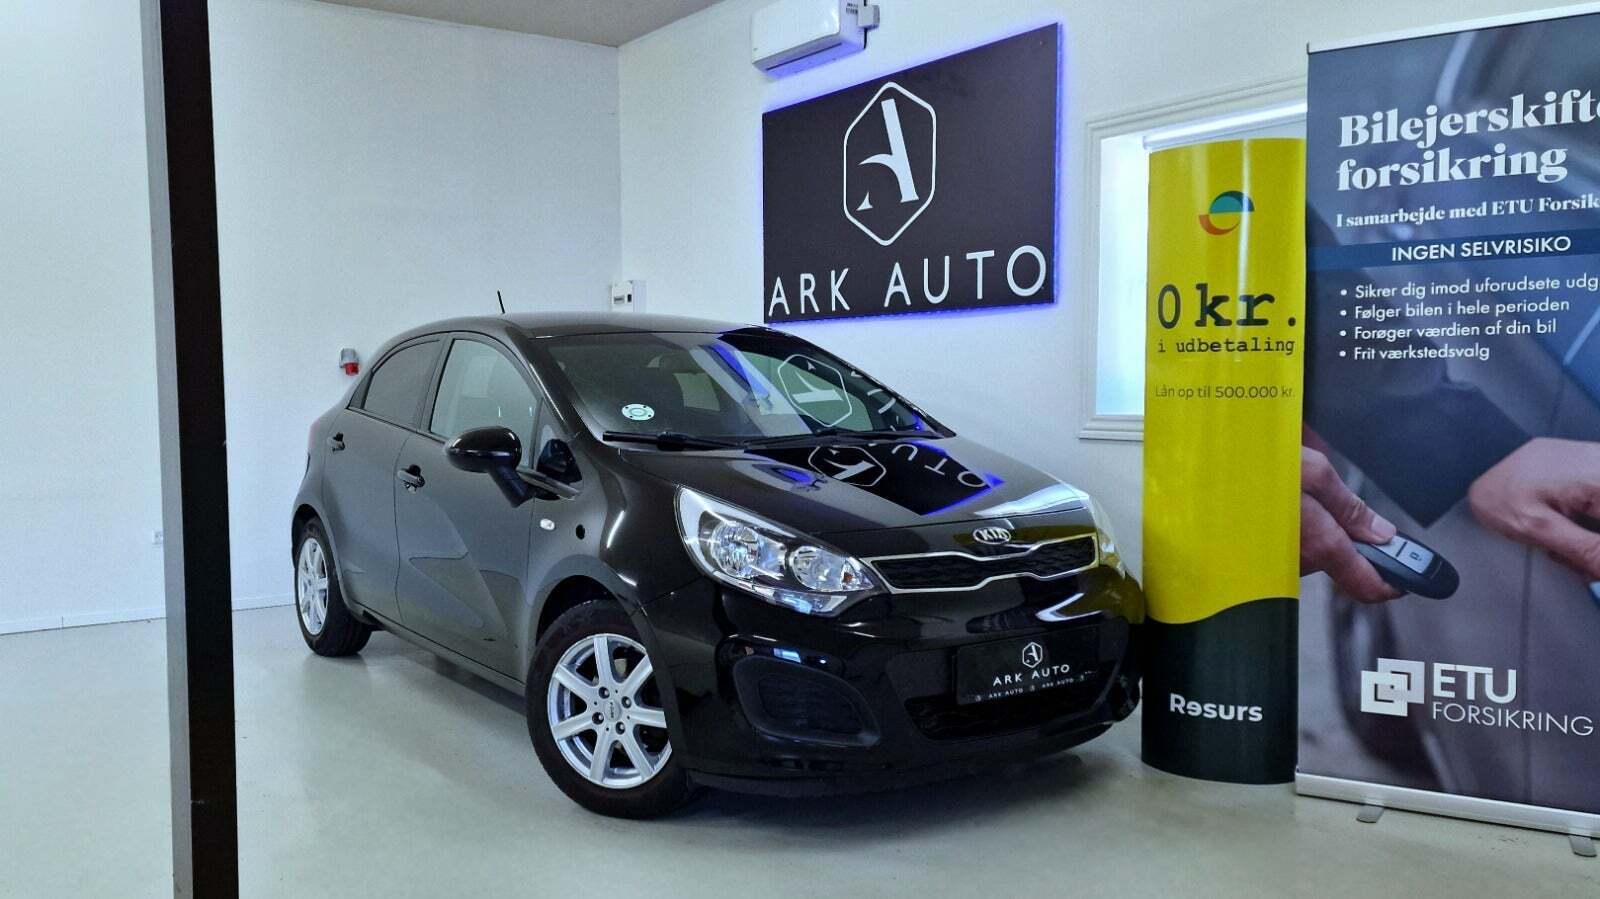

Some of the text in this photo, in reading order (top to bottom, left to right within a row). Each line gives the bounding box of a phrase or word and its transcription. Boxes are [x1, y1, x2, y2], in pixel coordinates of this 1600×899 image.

[1337, 142, 1568, 191] forsikring
[1336, 214, 1344, 228] I
[1346, 206, 1445, 227] samarbejde
[1450, 201, 1487, 219] med
[1492, 199, 1533, 216] ETU
[1391, 236, 1572, 262] INGEN SELVRISIKO
[768, 245, 1047, 317] ARK AUTO
[1355, 283, 1397, 298] Sikrer
[1401, 281, 1426, 299] dig
[1430, 279, 1470, 295] imod
[1475, 275, 1561, 293] uforudsete
[1157, 283, 1296, 329] 0 kr.
[1354, 304, 1400, 322] Følger
[1405, 301, 1443, 317] bilen
[1456, 299, 1490, 315] hele
[1495, 296, 1570, 317] perioden
[1354, 317, 1556, 342] Forøger værdien af din bil
[1157, 337, 1296, 356] i udbetaling
[1354, 343, 1490, 361] Frit værkstedsvalg
[1155, 384, 1176, 398] Lån
[1178, 386, 1195, 400] op
[1197, 385, 1212, 398] til
[1215, 385, 1279, 399] 500.000
[979, 527, 1010, 542] KIA
[992, 664, 1070, 687] ARK AUTO
[1433, 662, 1518, 704] ETU
[1432, 701, 1594, 737] FORSIKRING
